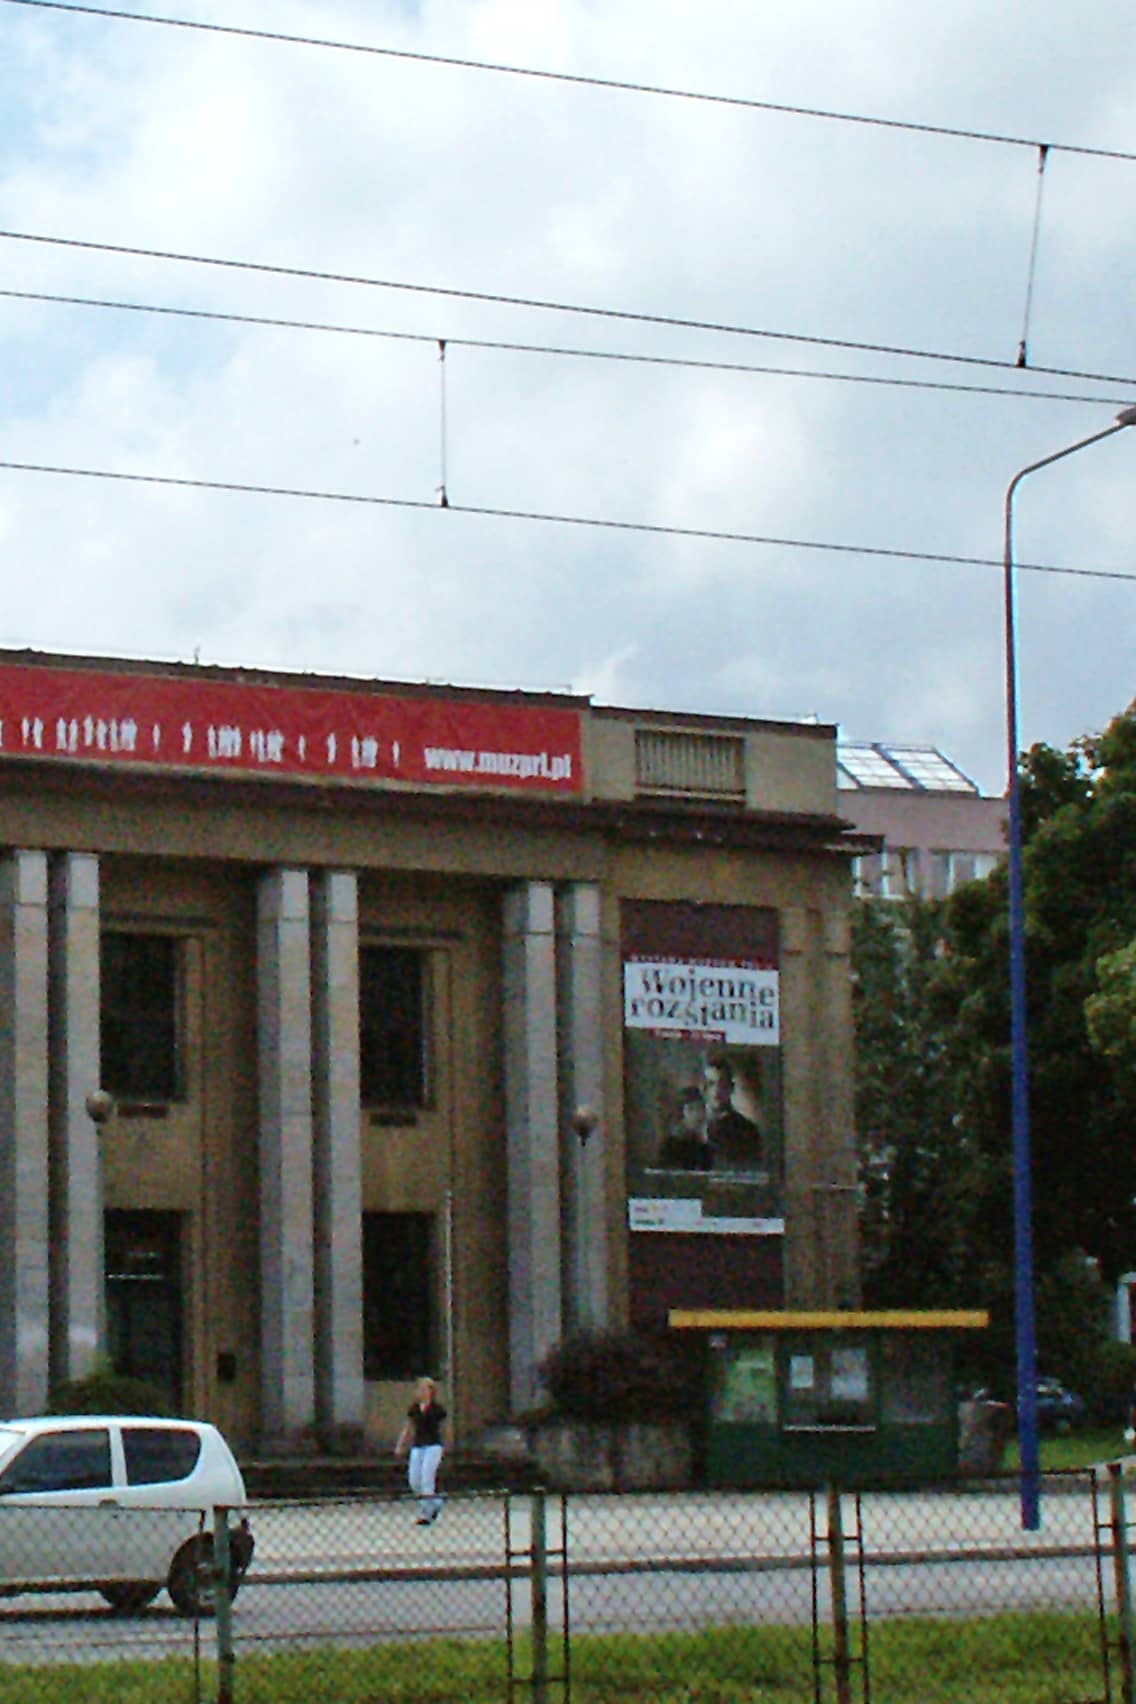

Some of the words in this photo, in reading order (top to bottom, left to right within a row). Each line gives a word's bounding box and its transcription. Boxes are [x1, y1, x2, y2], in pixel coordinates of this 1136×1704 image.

[424, 748, 572, 781] www.muzprl.pl
[640, 967, 775, 1007] Wojenne
[630, 998, 775, 1030] rozstania
